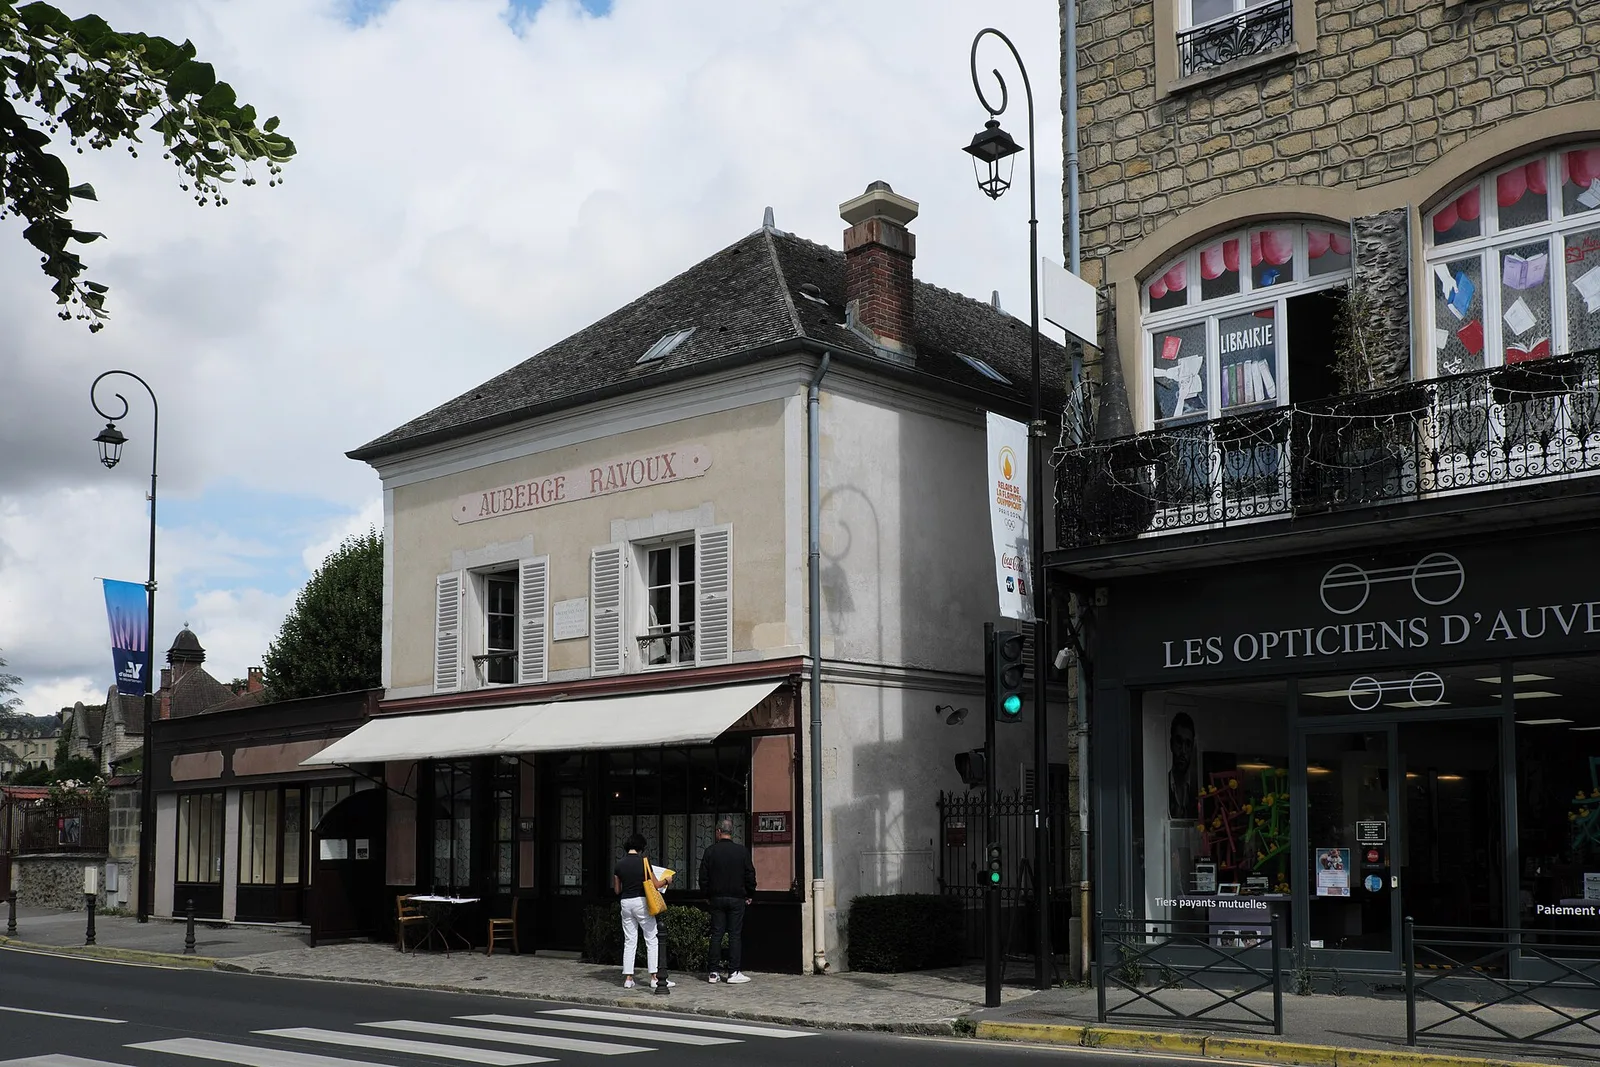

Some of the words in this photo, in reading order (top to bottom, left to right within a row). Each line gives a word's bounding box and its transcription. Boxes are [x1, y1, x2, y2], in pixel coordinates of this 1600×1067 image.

[1220, 324, 1273, 354] LIBRAIRIE
[478, 476, 566, 517] AUBERGE
[589, 452, 677, 494] RAVOUX
[1013, 485, 1020, 495] DE
[1162, 636, 1225, 669] LES
[1233, 616, 1430, 663] OPTICIENS
[1440, 601, 1600, 646] D'AUVE
[1155, 897, 1177, 907] Tiers
[1179, 898, 1217, 909] payants
[1218, 898, 1268, 910] mutuelles
[1536, 904, 1596, 916] Paiement
